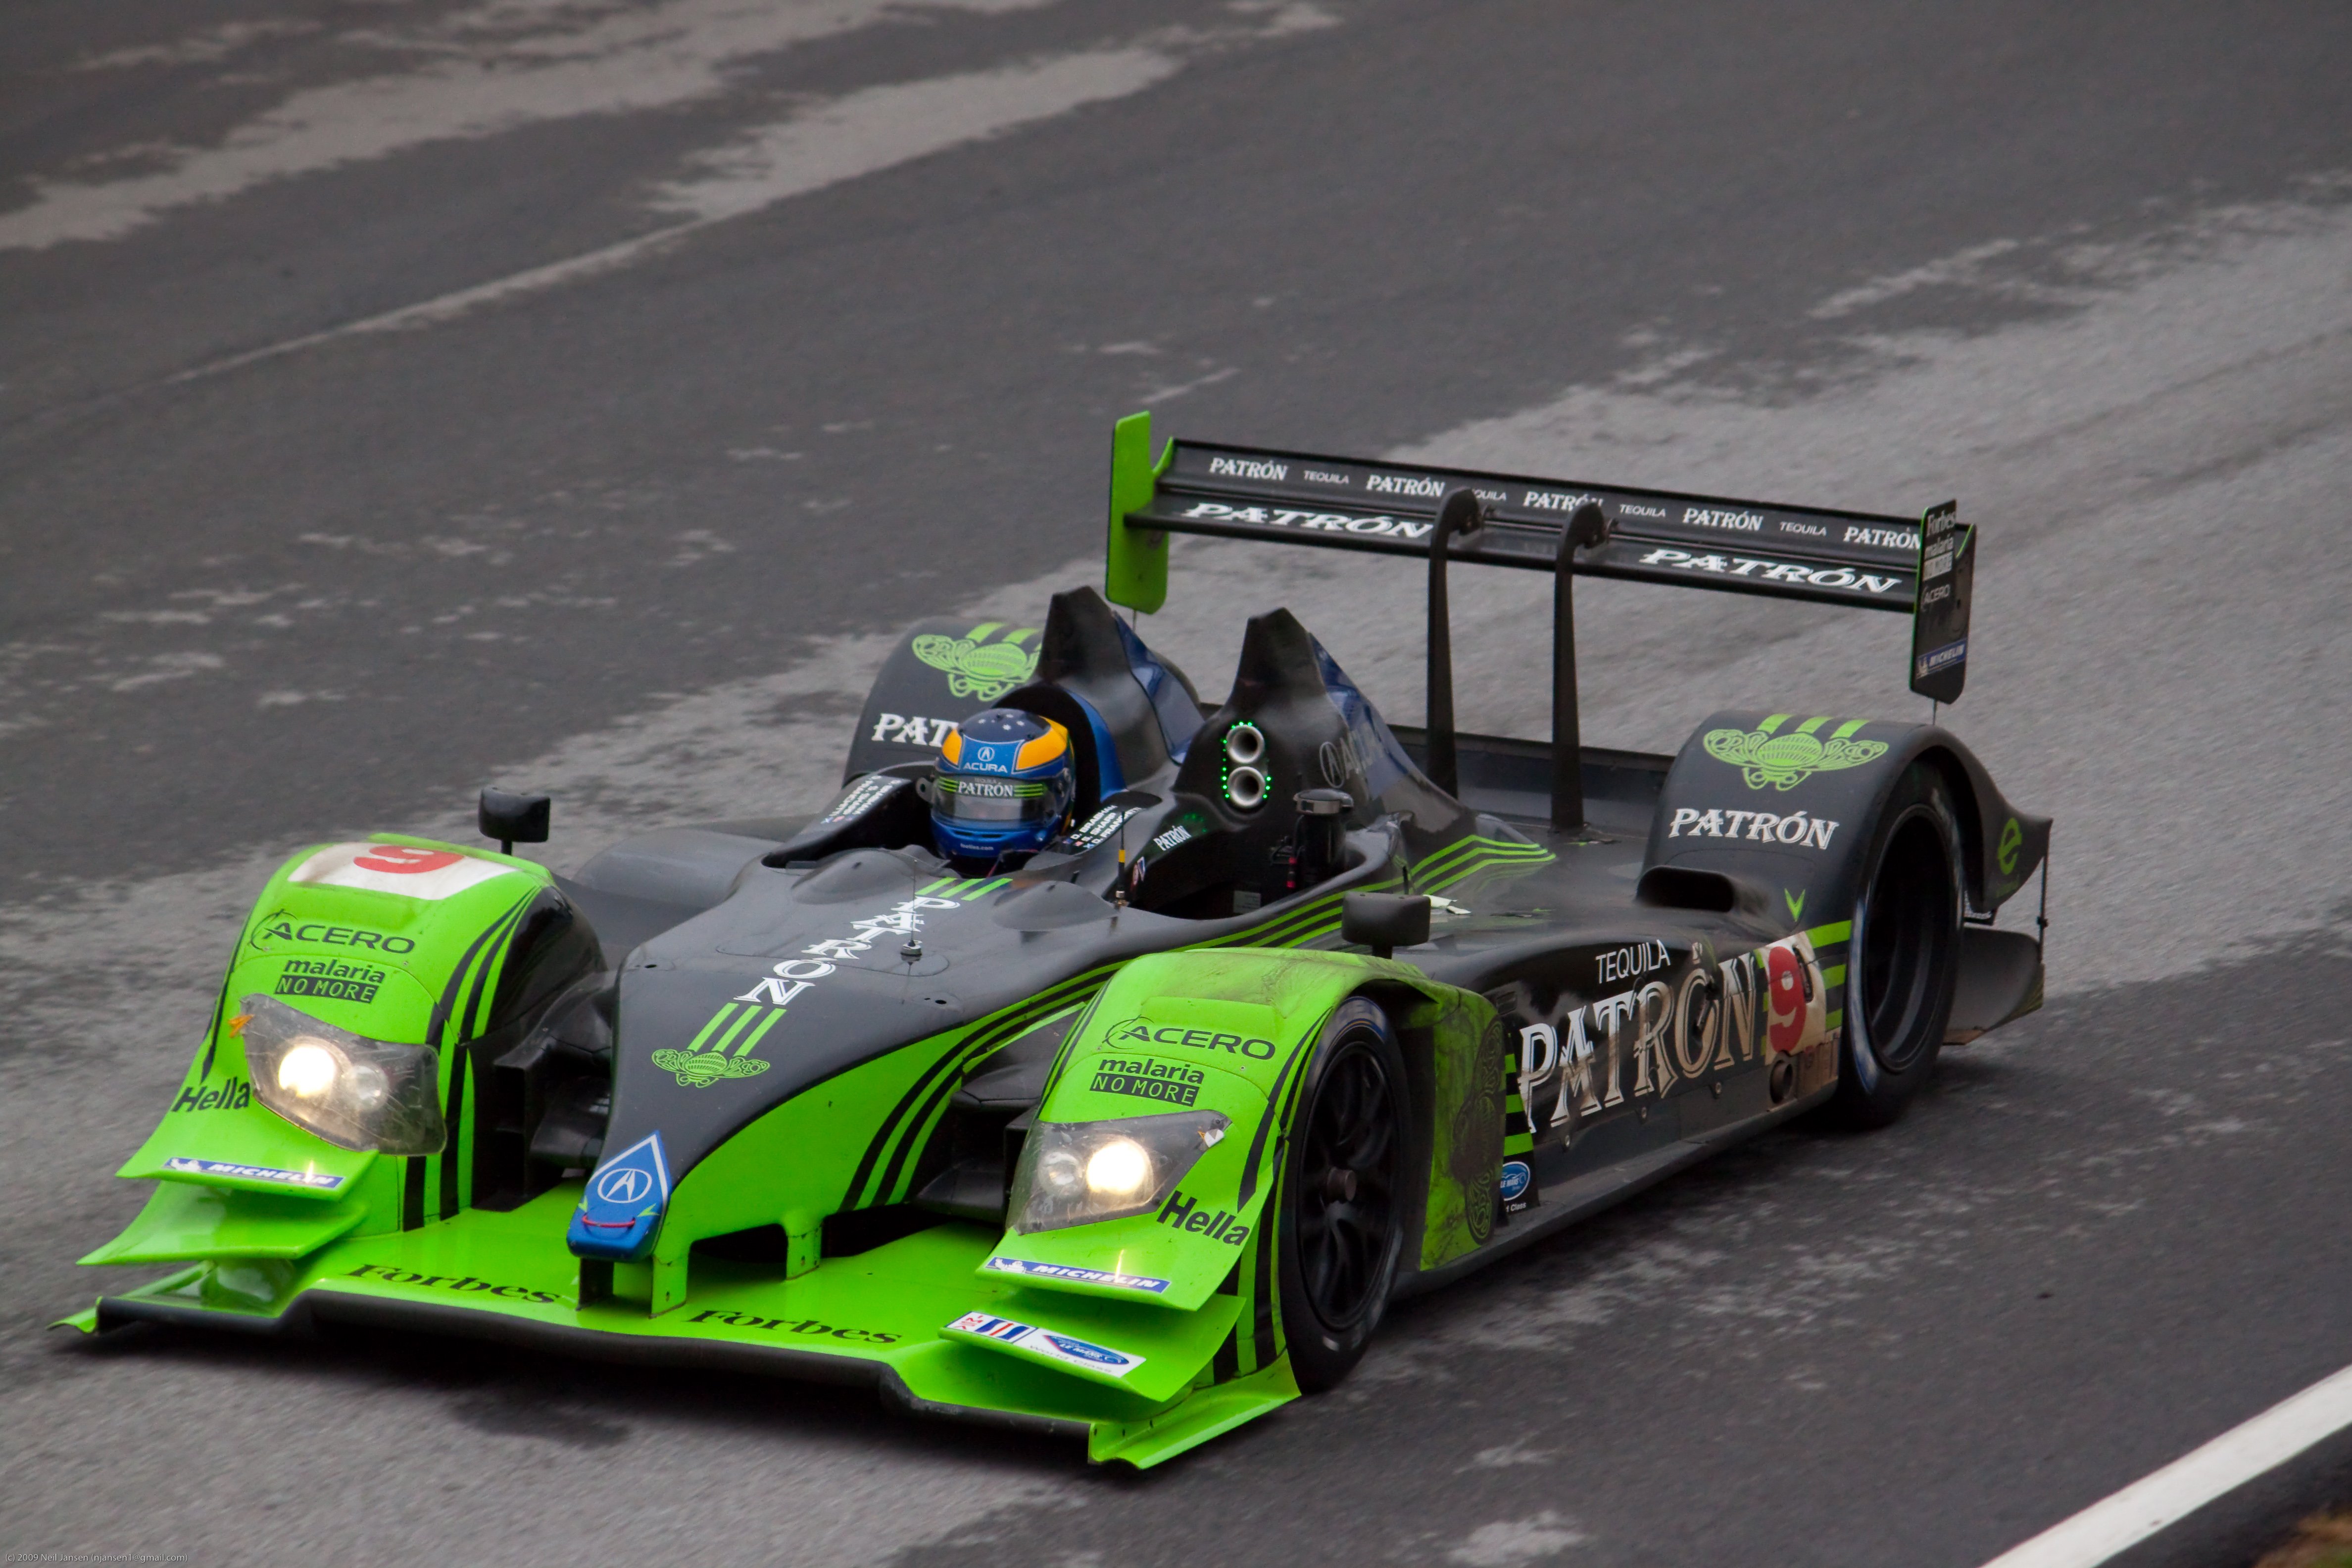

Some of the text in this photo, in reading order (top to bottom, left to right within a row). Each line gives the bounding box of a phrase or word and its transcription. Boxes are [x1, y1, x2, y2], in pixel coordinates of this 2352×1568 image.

[1209, 457, 1288, 481] PATRÓN
[1304, 470, 1350, 485] TEQUILA
[1366, 475, 1445, 497] PATRÓN
[1472, 488, 1507, 501] QUILA
[1619, 504, 1666, 518] TEQUILA
[1683, 507, 1763, 531] PATRÓN
[1780, 521, 1827, 537] TEQUILA
[1181, 502, 1433, 538] PATRÓN
[1639, 547, 1903, 593] PATRÓN
[963, 762, 1008, 773] ACURA
[958, 781, 1014, 797] PATRÓN
[1153, 825, 1192, 851] PATRÓN
[1669, 808, 1839, 850] PATRÓN
[353, 845, 466, 874] 9
[262, 922, 415, 954] ACERO
[283, 959, 386, 983] malaria
[1595, 939, 1671, 984] TEQUILA
[277, 978, 376, 1003] NO MORE
[1768, 946, 1807, 1053] 9
[1118, 1026, 1276, 1060] ACERO
[1098, 1058, 1205, 1084] malaria
[172, 1077, 250, 1112] Hella
[1092, 1075, 1196, 1105] NO MORE
[1157, 1190, 1250, 1246] Hella
[344, 1264, 561, 1303] Forbes
[1032, 1265, 1161, 1288] MICHELIN
[687, 1310, 902, 1344] Forbes
